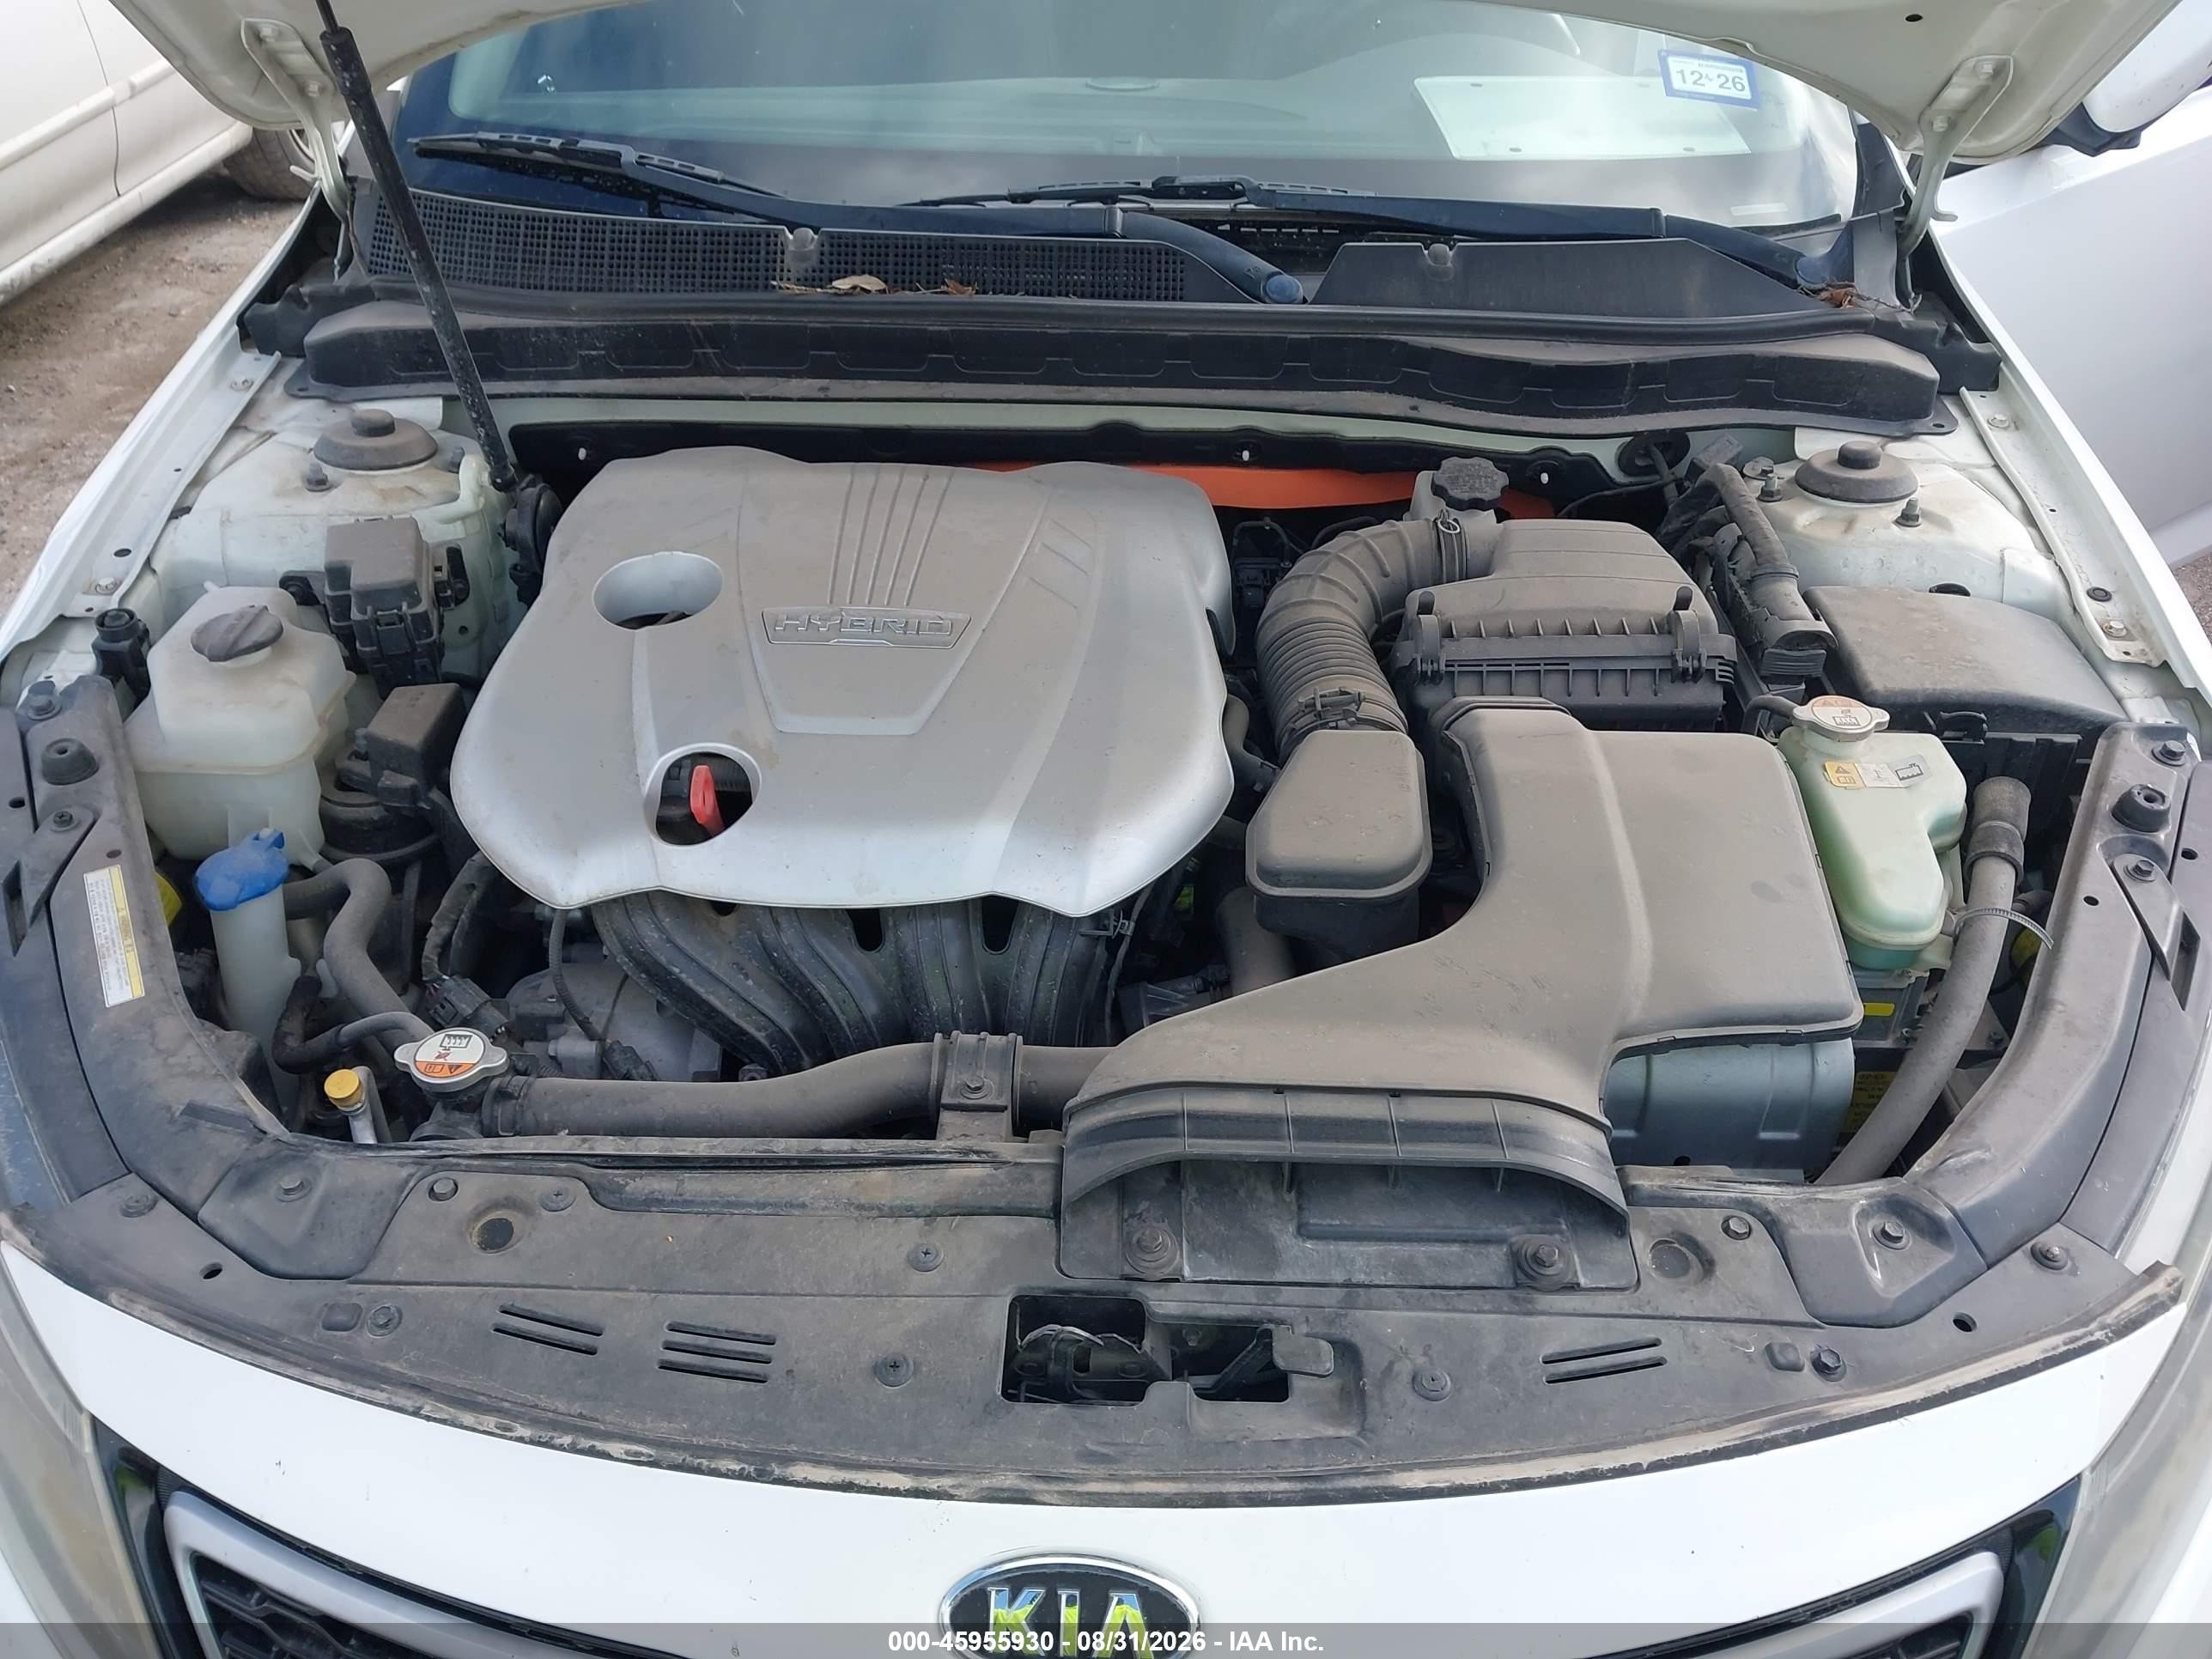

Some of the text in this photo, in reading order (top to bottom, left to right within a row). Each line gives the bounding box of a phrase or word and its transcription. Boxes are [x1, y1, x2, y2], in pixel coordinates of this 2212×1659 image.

[1675, 69, 1746, 92] 12 26
[775, 614, 952, 636] HYBRID
[988, 1586, 1156, 1659] KIA
